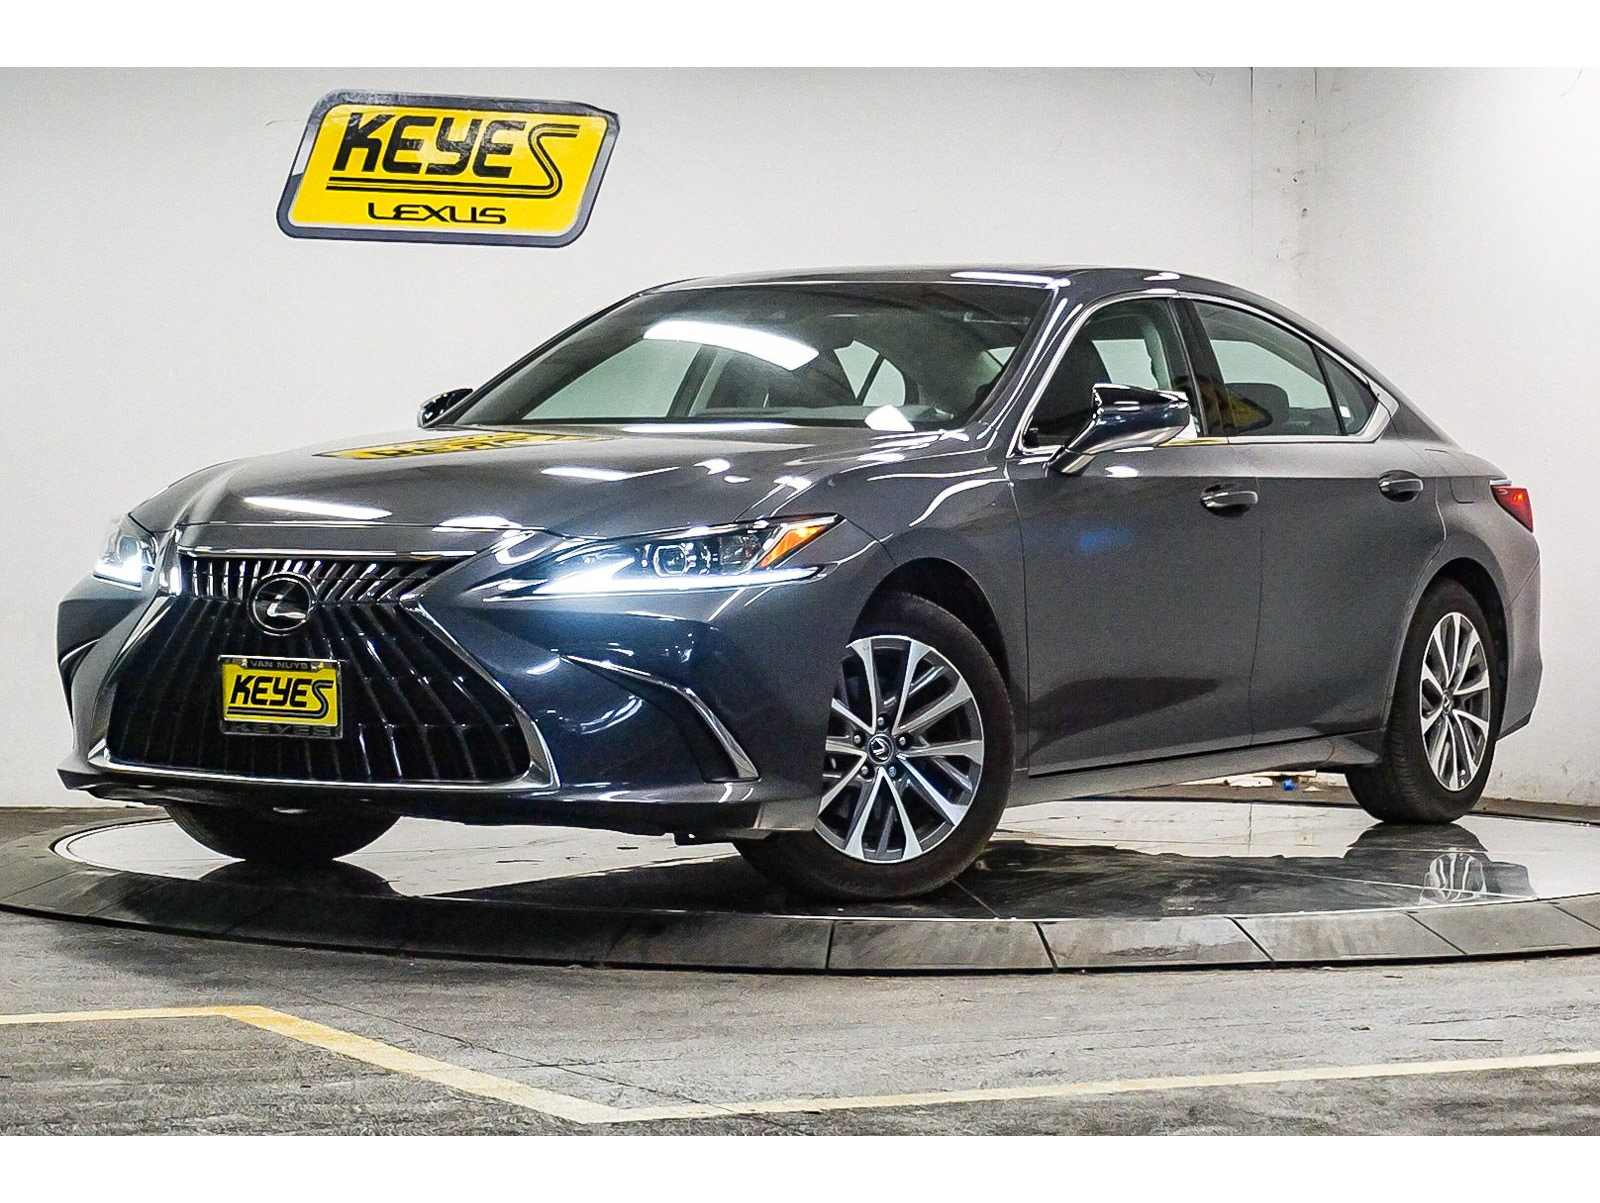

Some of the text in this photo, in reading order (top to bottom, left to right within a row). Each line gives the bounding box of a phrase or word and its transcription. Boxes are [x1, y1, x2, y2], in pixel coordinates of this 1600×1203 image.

[327, 112, 580, 199] KEYES
[367, 203, 507, 224] LEXUS
[228, 675, 334, 719] KEYES
